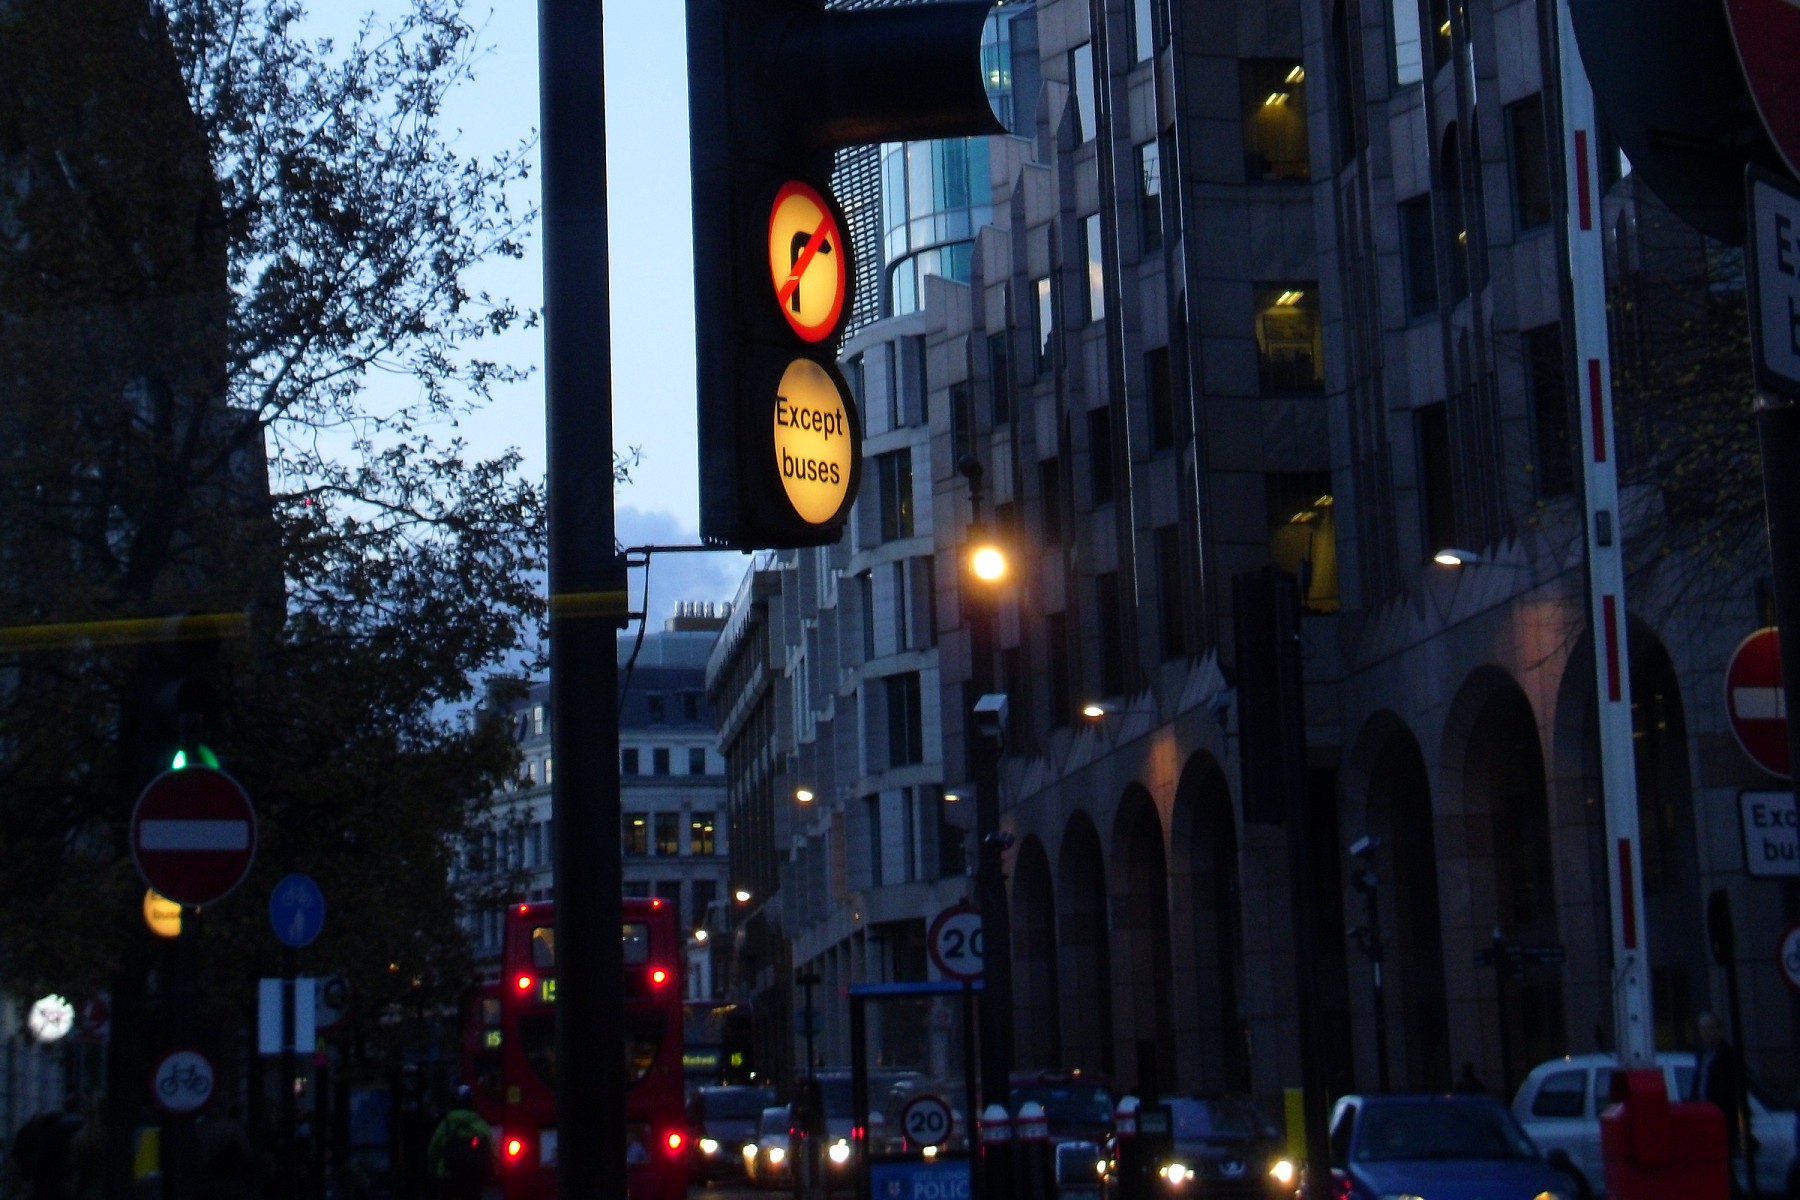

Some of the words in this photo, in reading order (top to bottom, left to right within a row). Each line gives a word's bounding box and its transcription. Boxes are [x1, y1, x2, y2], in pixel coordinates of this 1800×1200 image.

[777, 396, 843, 441] Except
[782, 446, 841, 485] buses
[1763, 837, 1794, 861] bu
[910, 1111, 943, 1132] 20
